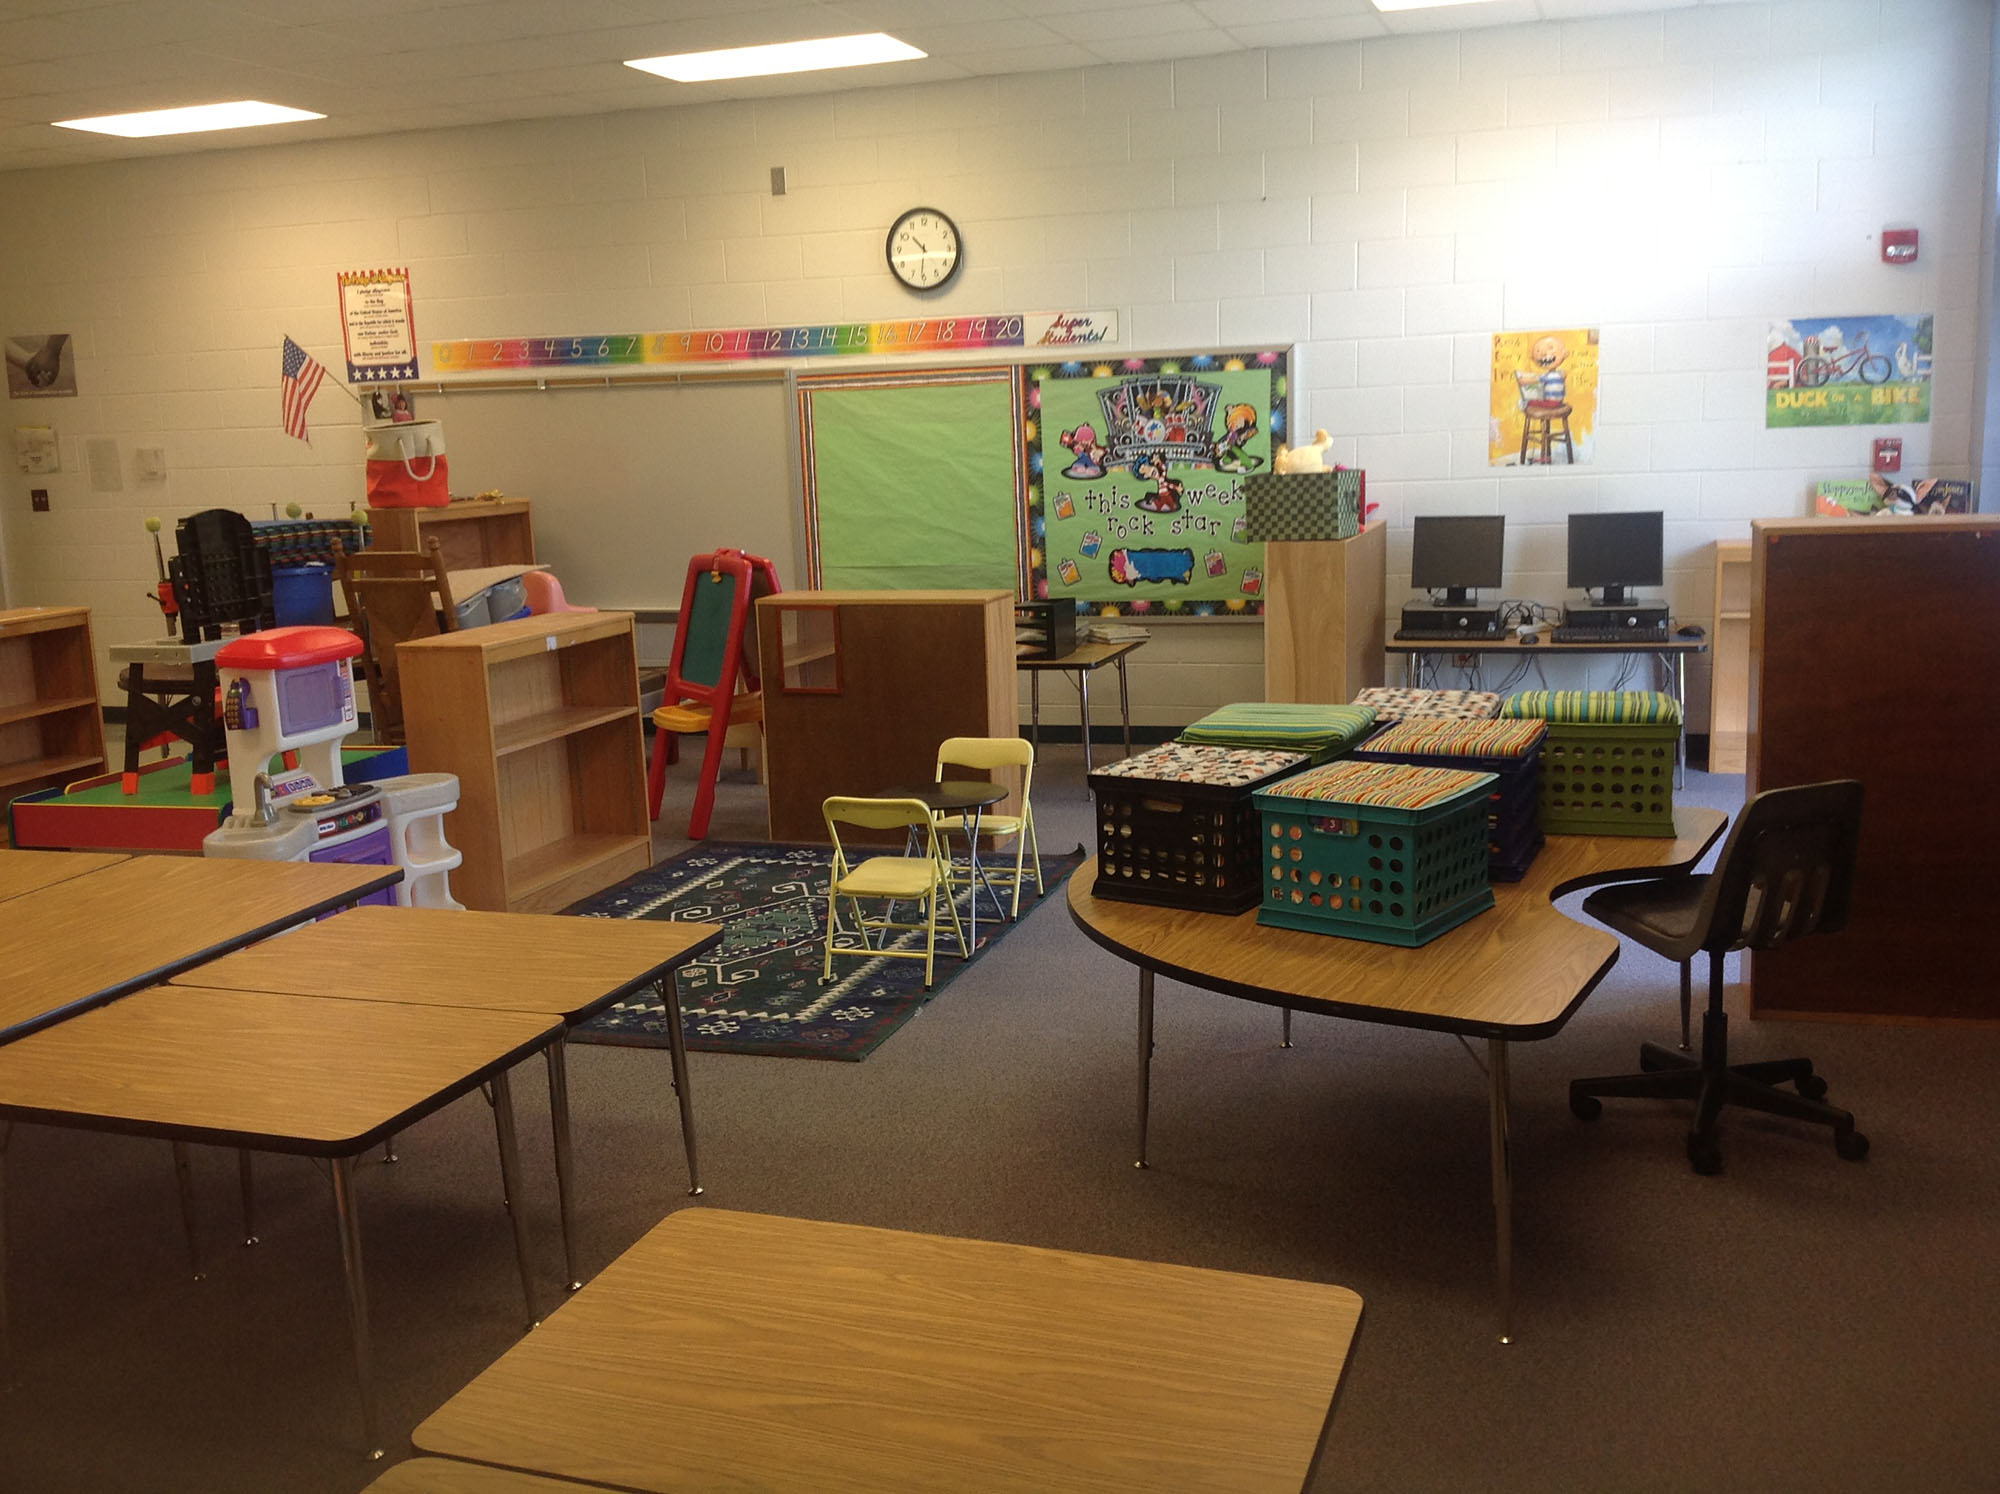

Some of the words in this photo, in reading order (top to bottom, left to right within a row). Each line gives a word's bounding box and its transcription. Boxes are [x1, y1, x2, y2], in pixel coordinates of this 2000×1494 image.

[468, 343, 475, 361] 1
[492, 342, 503, 361] 2
[518, 341, 530, 360] 3
[544, 339, 557, 359] 4
[570, 338, 582, 358] 5
[598, 338, 609, 357] 6
[626, 335, 638, 355] 7
[680, 334, 692, 353] 9
[704, 332, 724, 353] 10
[734, 331, 751, 352] 11
[763, 330, 782, 351] 12
[789, 329, 810, 349] 13
[818, 327, 839, 348] 14
[847, 325, 868, 346] 15
[878, 324, 897, 345] 16
[906, 322, 927, 343] 17
[936, 320, 956, 342] 18
[967, 318, 988, 340] 19
[995, 317, 1022, 339] 20
[1049, 314, 1093, 334] Super
[1775, 390, 1828, 409] DUCK
[1870, 386, 1921, 405] BIKE
[1084, 485, 1130, 514] this
[1186, 479, 1244, 506] week
[1107, 514, 1154, 539] rock
[1171, 508, 1222, 536] star
